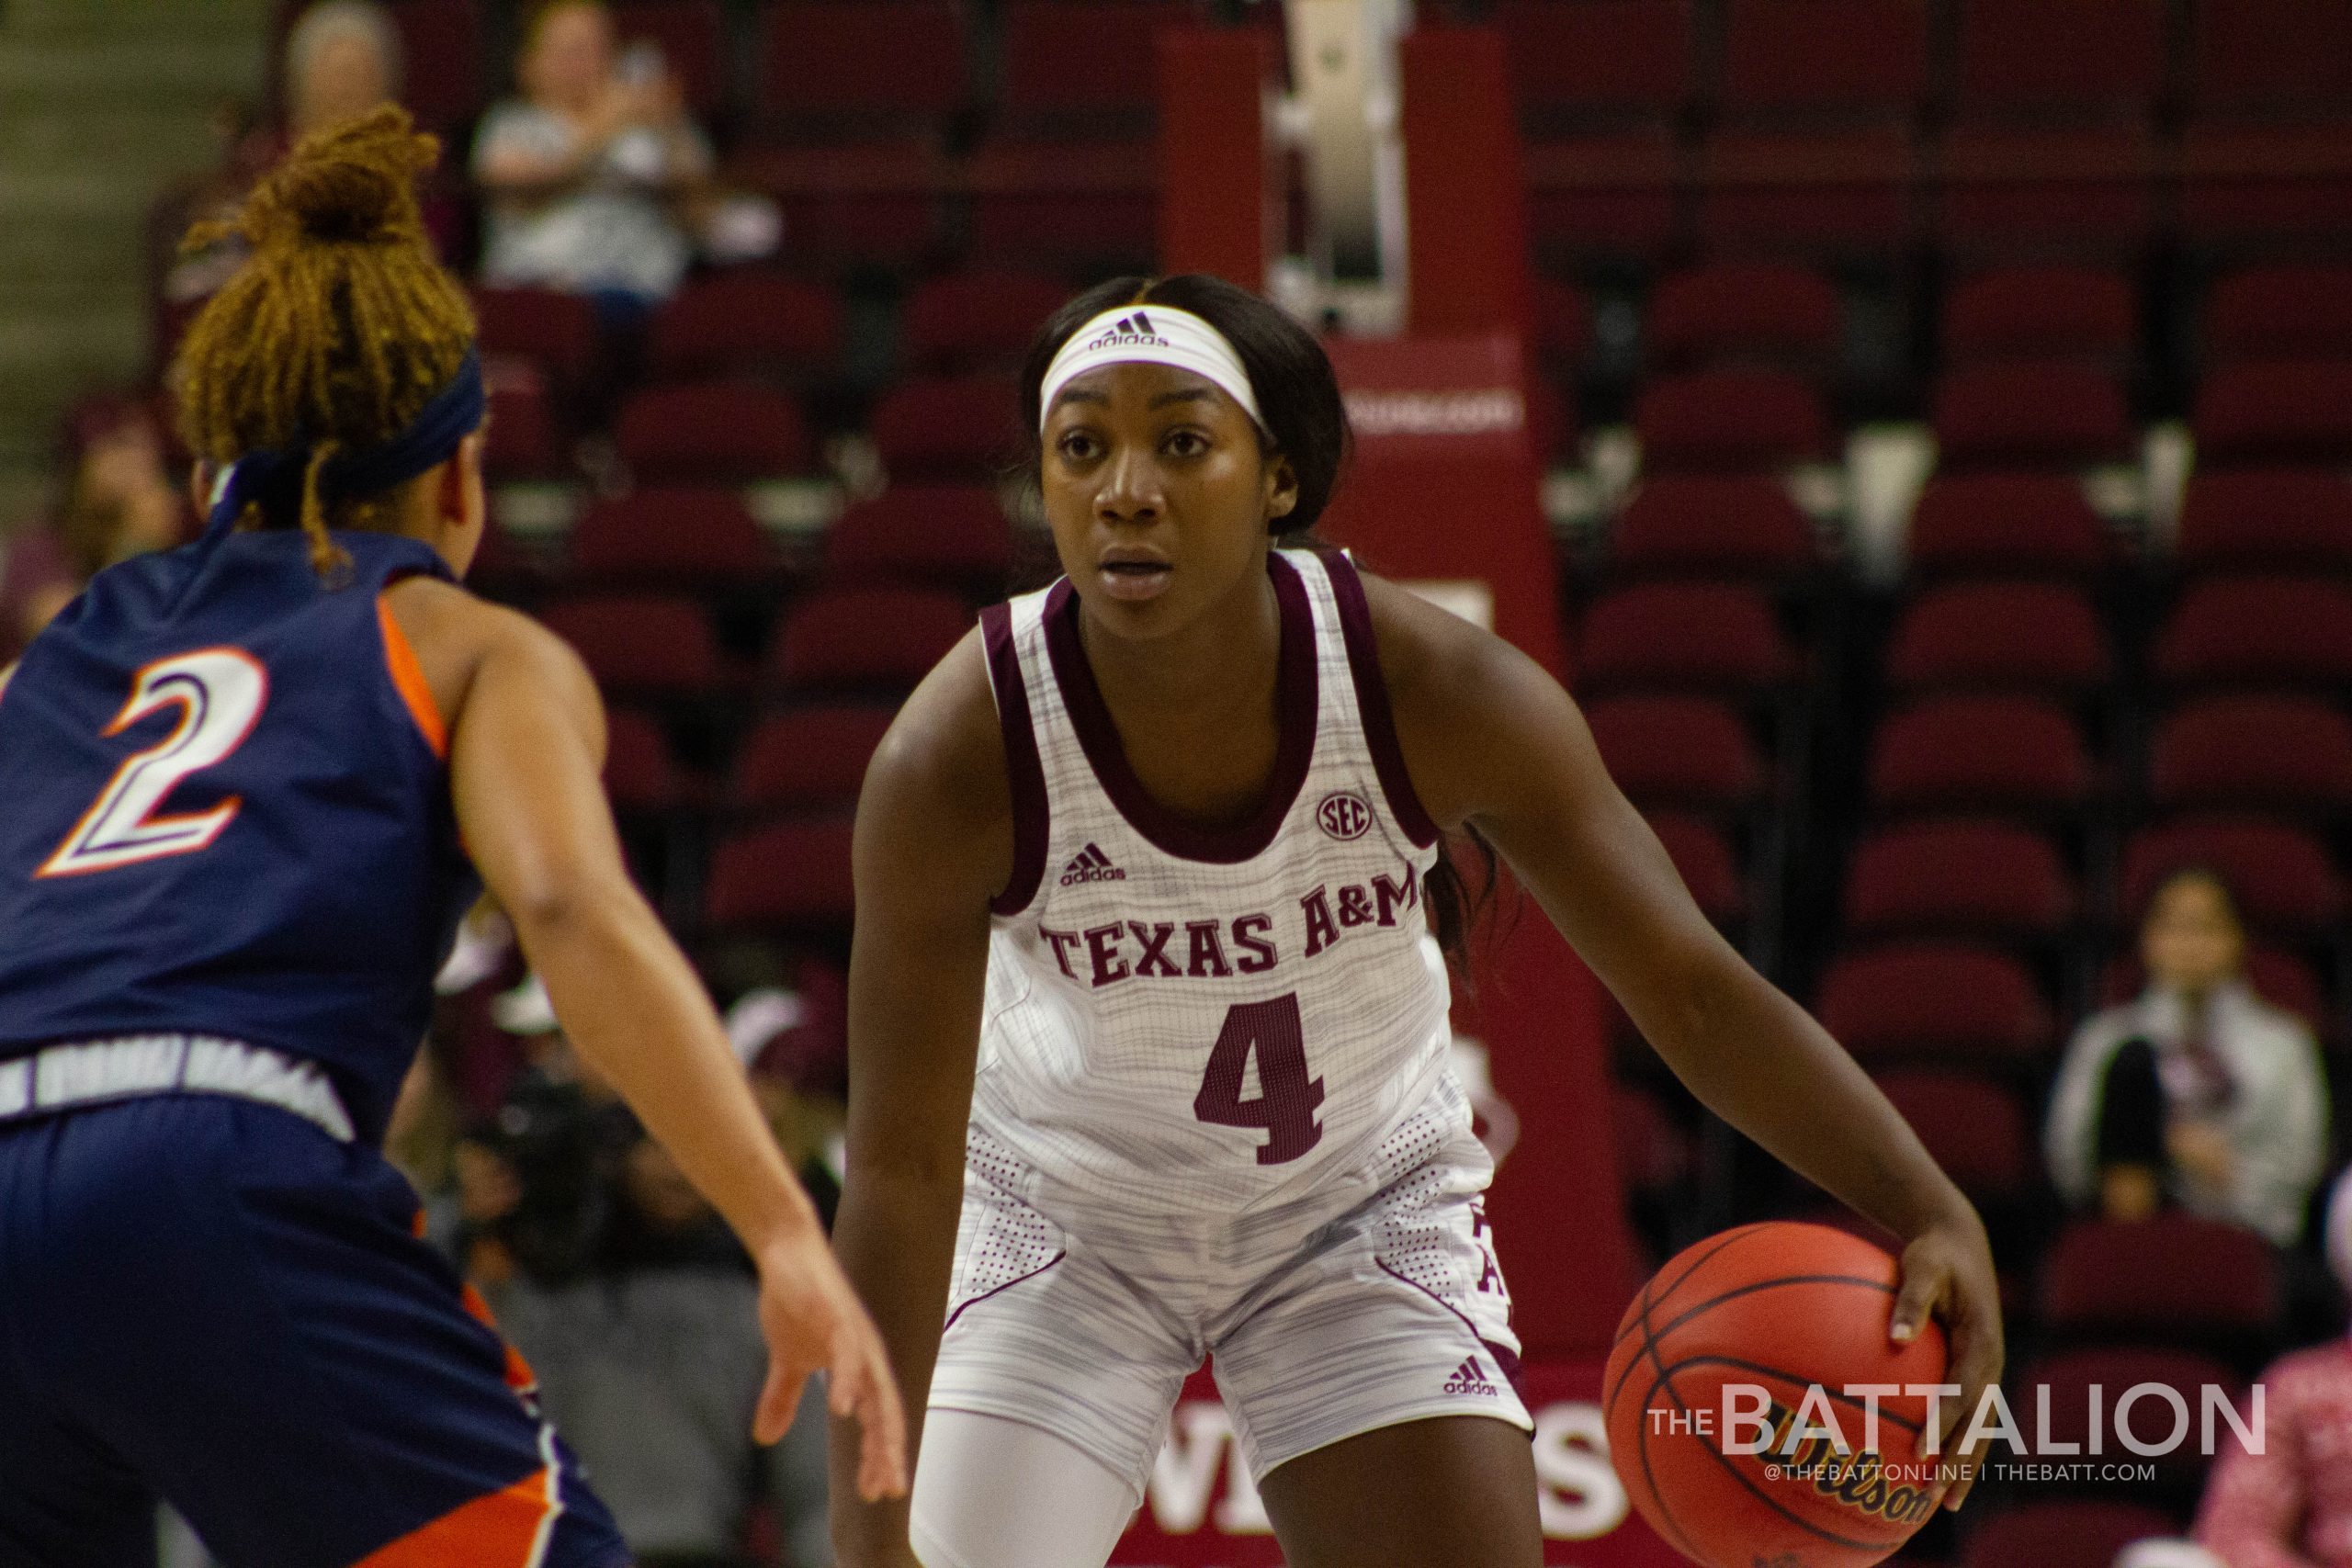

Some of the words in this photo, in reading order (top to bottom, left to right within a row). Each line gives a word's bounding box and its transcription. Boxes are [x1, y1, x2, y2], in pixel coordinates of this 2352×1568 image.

[1088, 333, 1170, 352] adidas
[33, 646, 269, 880] 2
[1321, 793, 1369, 837] SEC
[1059, 866, 1126, 887] adidas
[1039, 913, 1279, 987] TEXAS
[1300, 860, 1419, 958] A&M
[1193, 990, 1326, 1166] 4
[1442, 1378, 1498, 1397] adidas
